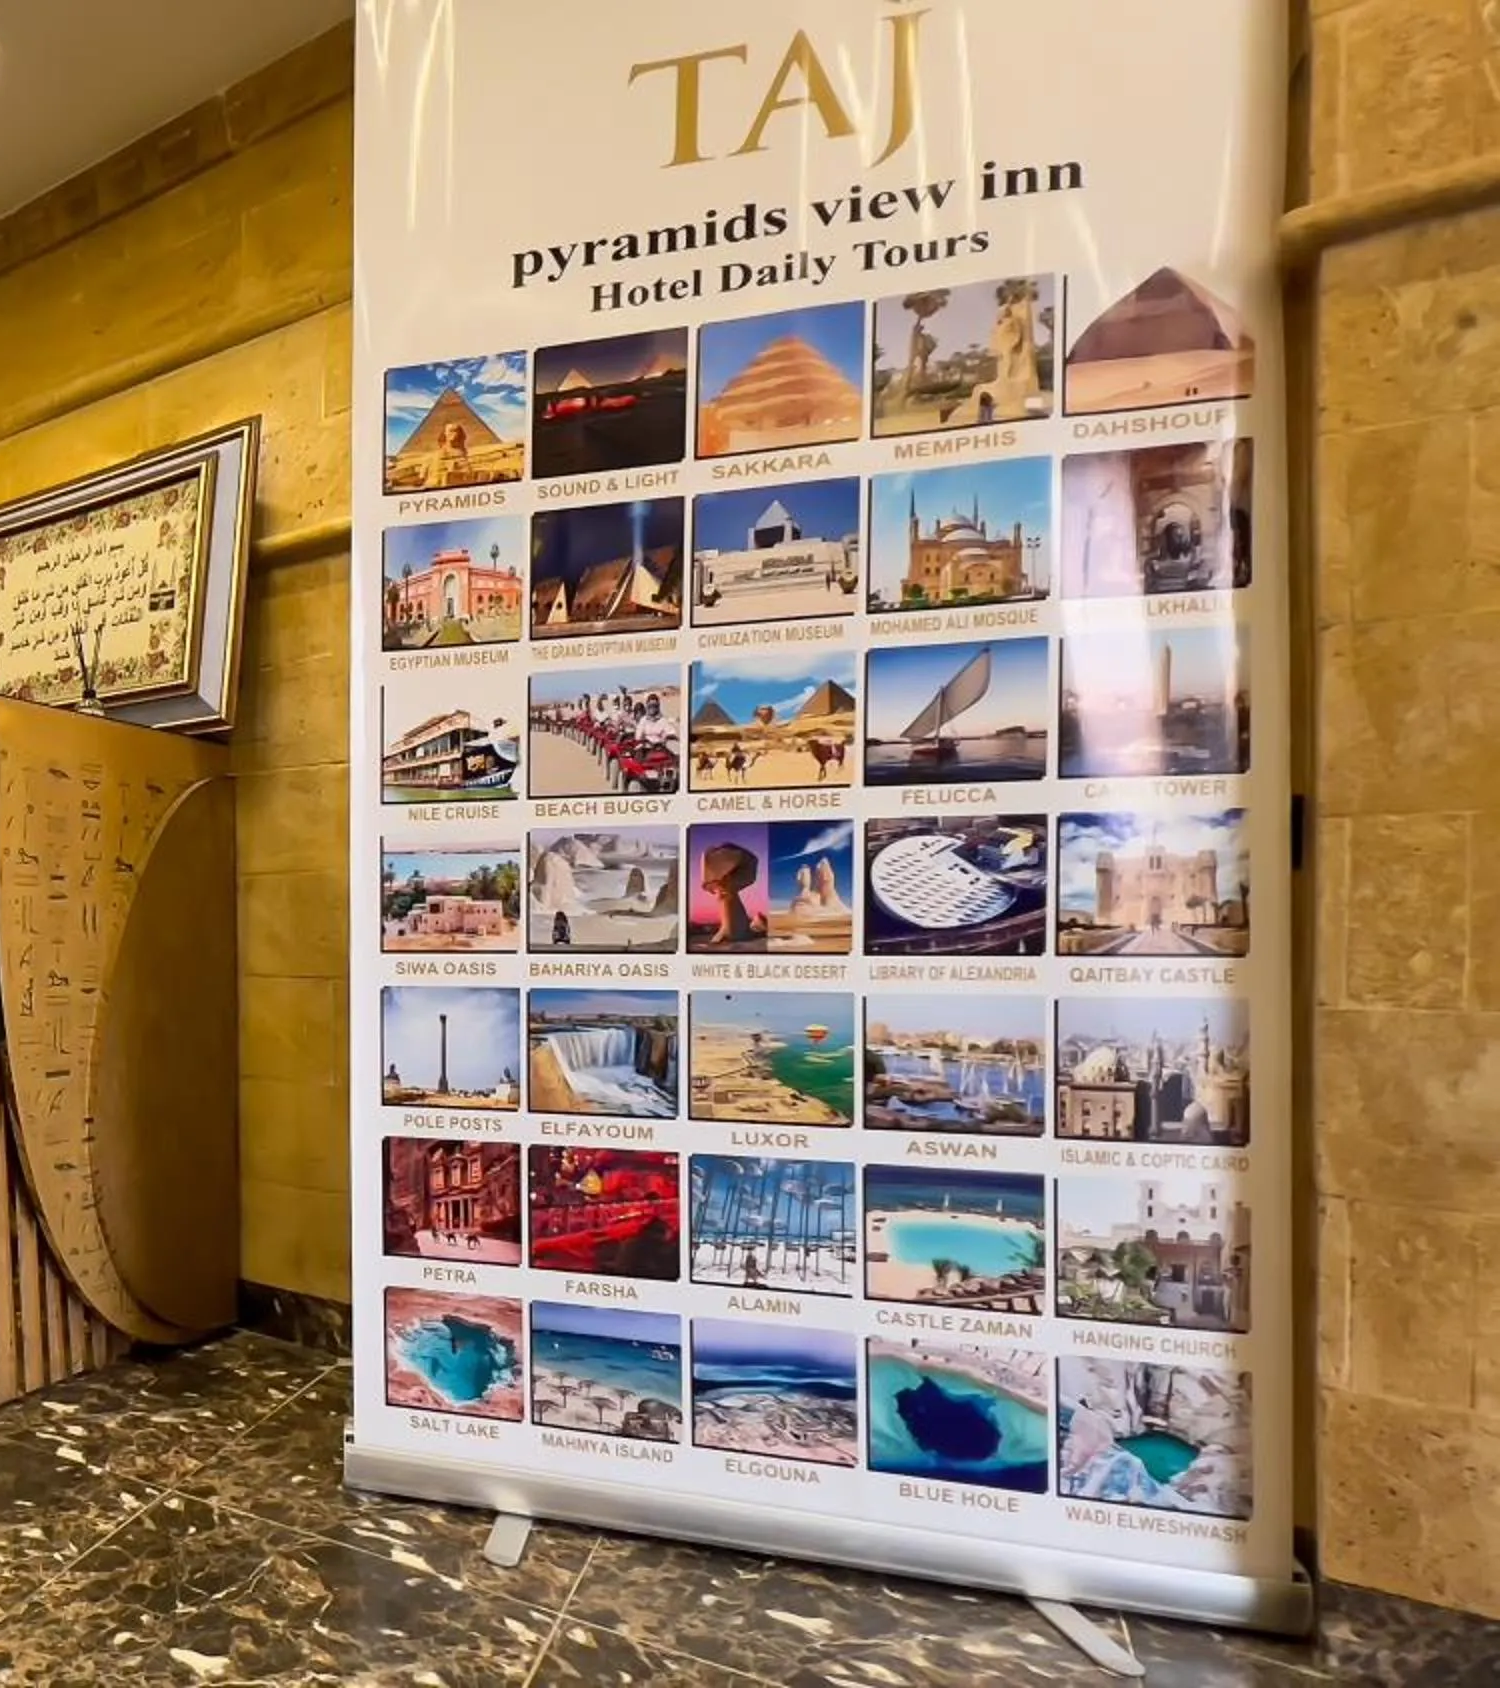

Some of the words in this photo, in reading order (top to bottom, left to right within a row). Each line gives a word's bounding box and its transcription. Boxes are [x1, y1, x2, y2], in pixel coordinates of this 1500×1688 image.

[628, 8, 933, 170] TAJ
[511, 202, 787, 288] pyramids
[810, 183, 955, 226] view
[980, 160, 1084, 200] inn
[590, 271, 701, 312] Hotel
[720, 251, 836, 286] Daily
[854, 231, 990, 271] Tours
[894, 430, 1017, 460] MEMPHIS
[711, 450, 832, 480] SAKKARA
[537, 479, 600, 499] SOUND
[606, 478, 619, 492] &
[625, 470, 679, 489] LIGHT
[398, 490, 506, 515] PYRAMIDS
[870, 615, 942, 635] MOHAMED
[946, 613, 971, 630] ALI
[974, 608, 1038, 628] MOSQUE
[699, 627, 781, 649] CIVILIZATION
[786, 622, 844, 641] MUSEUM
[532, 645, 547, 661] THE
[548, 642, 582, 659] GRAND
[585, 639, 633, 657] EGYPTIAN
[635, 636, 677, 653] MUSEUM
[389, 652, 450, 671] EGYPTIAN
[454, 649, 509, 667] MUSEUM
[697, 795, 757, 811] CAMEL
[761, 795, 773, 809] &
[779, 793, 841, 809] HORSE
[902, 787, 997, 805] FELUCCA
[408, 806, 441, 821] NILE
[445, 804, 500, 820] CRUISE
[535, 800, 598, 817] BEACH
[604, 799, 671, 815] BUGGY
[395, 961, 439, 976] SIWA
[443, 962, 497, 976] OASIS
[529, 962, 613, 978] BAHARIYA
[618, 963, 669, 978] OASIS
[691, 963, 730, 978] WHITE
[734, 964, 743, 978] &
[747, 964, 790, 979] BLACK
[794, 965, 847, 980] DESERT
[869, 964, 924, 982] LIBRARY
[928, 965, 946, 982] OF
[949, 965, 1037, 982] ALEXANDRIA
[1070, 966, 1151, 985] QAITBAY
[1160, 967, 1236, 985] CASTLE
[403, 1113, 446, 1131] POLE
[449, 1116, 503, 1133] POSTS
[540, 1121, 655, 1142] ELFAYOUM
[730, 1131, 809, 1149] LUXOR
[906, 1140, 998, 1160] ASWAN
[1061, 1149, 1121, 1167] ISLAMIC
[1141, 1153, 1196, 1169] COPTIC
[422, 1266, 477, 1286] PETRA
[565, 1279, 639, 1300] FARSHA
[727, 1295, 801, 1316] ALAMIN
[876, 1310, 953, 1332] CASTLE
[959, 1318, 1034, 1340] ZAMAN
[1072, 1330, 1154, 1353] HANGING
[1160, 1338, 1238, 1360] CHURCH
[408, 1414, 450, 1433] SALT
[456, 1422, 500, 1440] LAKE
[541, 1432, 610, 1457] MAHMYA
[615, 1442, 675, 1463] ISLAND
[724, 1458, 821, 1485] ELGOUNA
[899, 1483, 954, 1506] BLUE
[961, 1490, 1020, 1514] HOLE
[1065, 1505, 1112, 1527] WADI
[1116, 1511, 1247, 1543] ELWESHWASH
